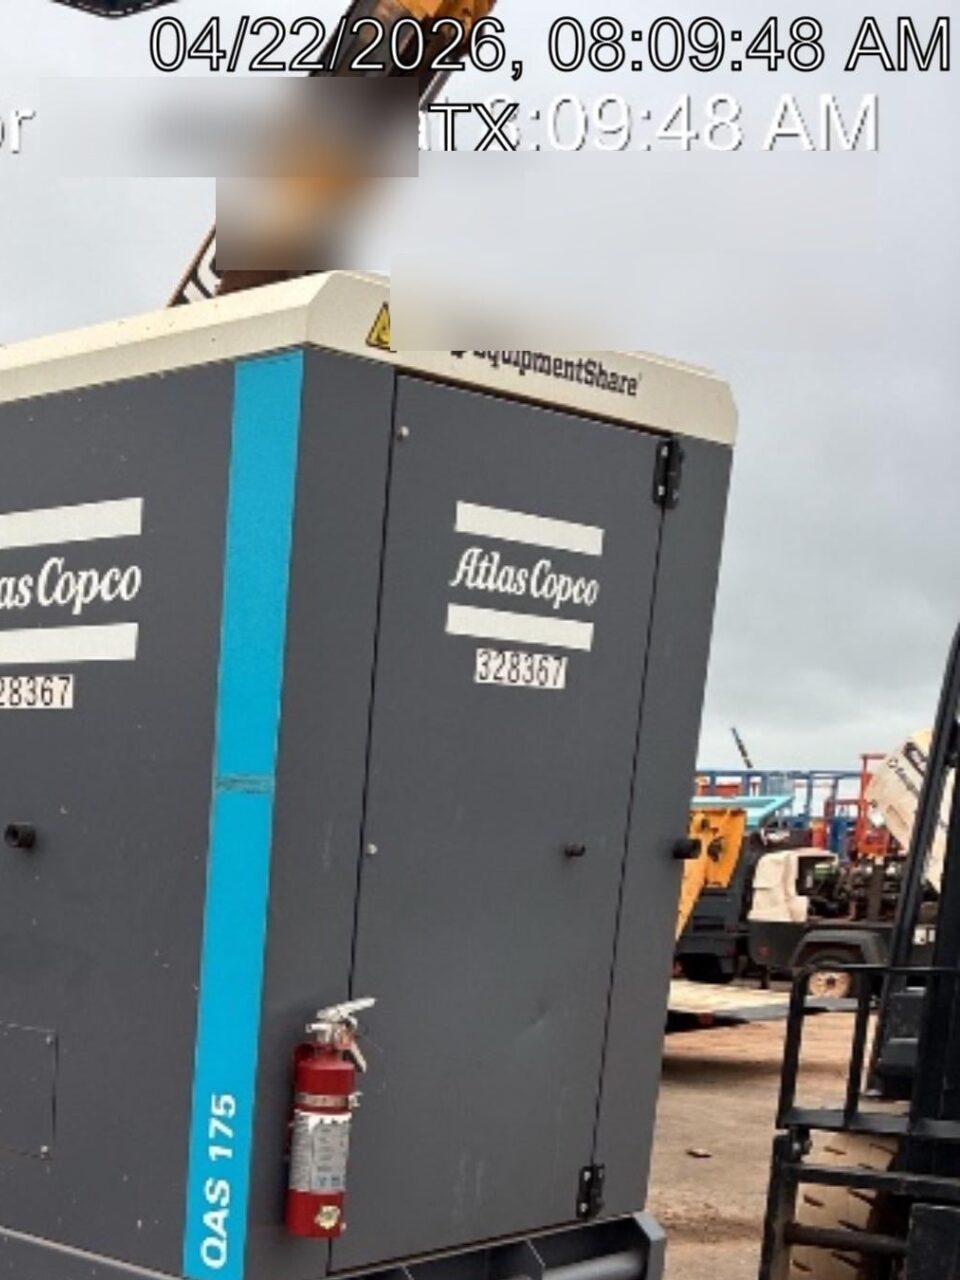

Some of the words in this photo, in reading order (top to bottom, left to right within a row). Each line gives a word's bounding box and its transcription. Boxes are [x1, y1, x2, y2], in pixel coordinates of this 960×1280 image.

[38, 556, 142, 616] Copco
[449, 547, 529, 595] Atlas
[530, 558, 600, 610] Copco
[477, 649, 564, 687] 328367
[208, 1093, 237, 1161] 175
[200, 1177, 230, 1270] QAS
